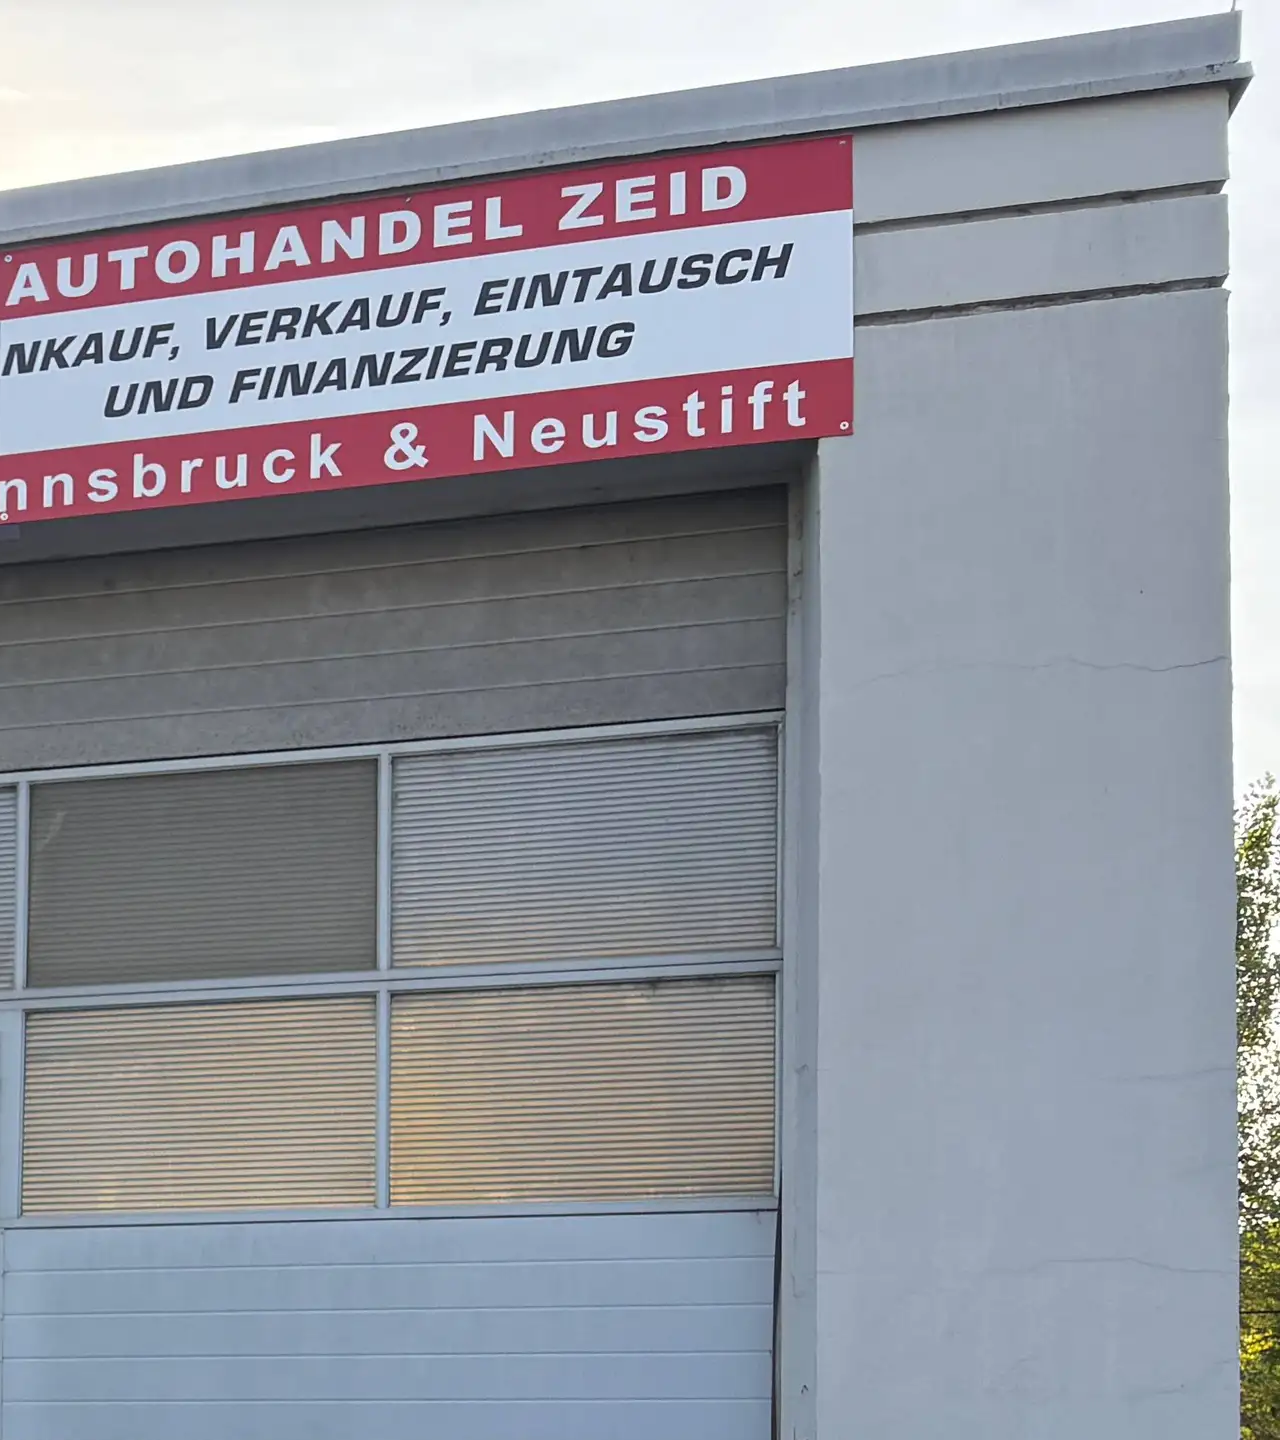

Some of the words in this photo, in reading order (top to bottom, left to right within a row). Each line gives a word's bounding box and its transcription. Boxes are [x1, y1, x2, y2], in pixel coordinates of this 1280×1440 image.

[5, 196, 523, 307] AUTOHANDEL
[558, 165, 747, 231] ZEID
[206, 287, 453, 350] VERKAUF,
[473, 243, 794, 316] EINTAUSCH
[104, 375, 214, 418] UND
[228, 322, 635, 404] FINANZIERUNG
[383, 422, 429, 471] &
[473, 379, 807, 461] Neustift
